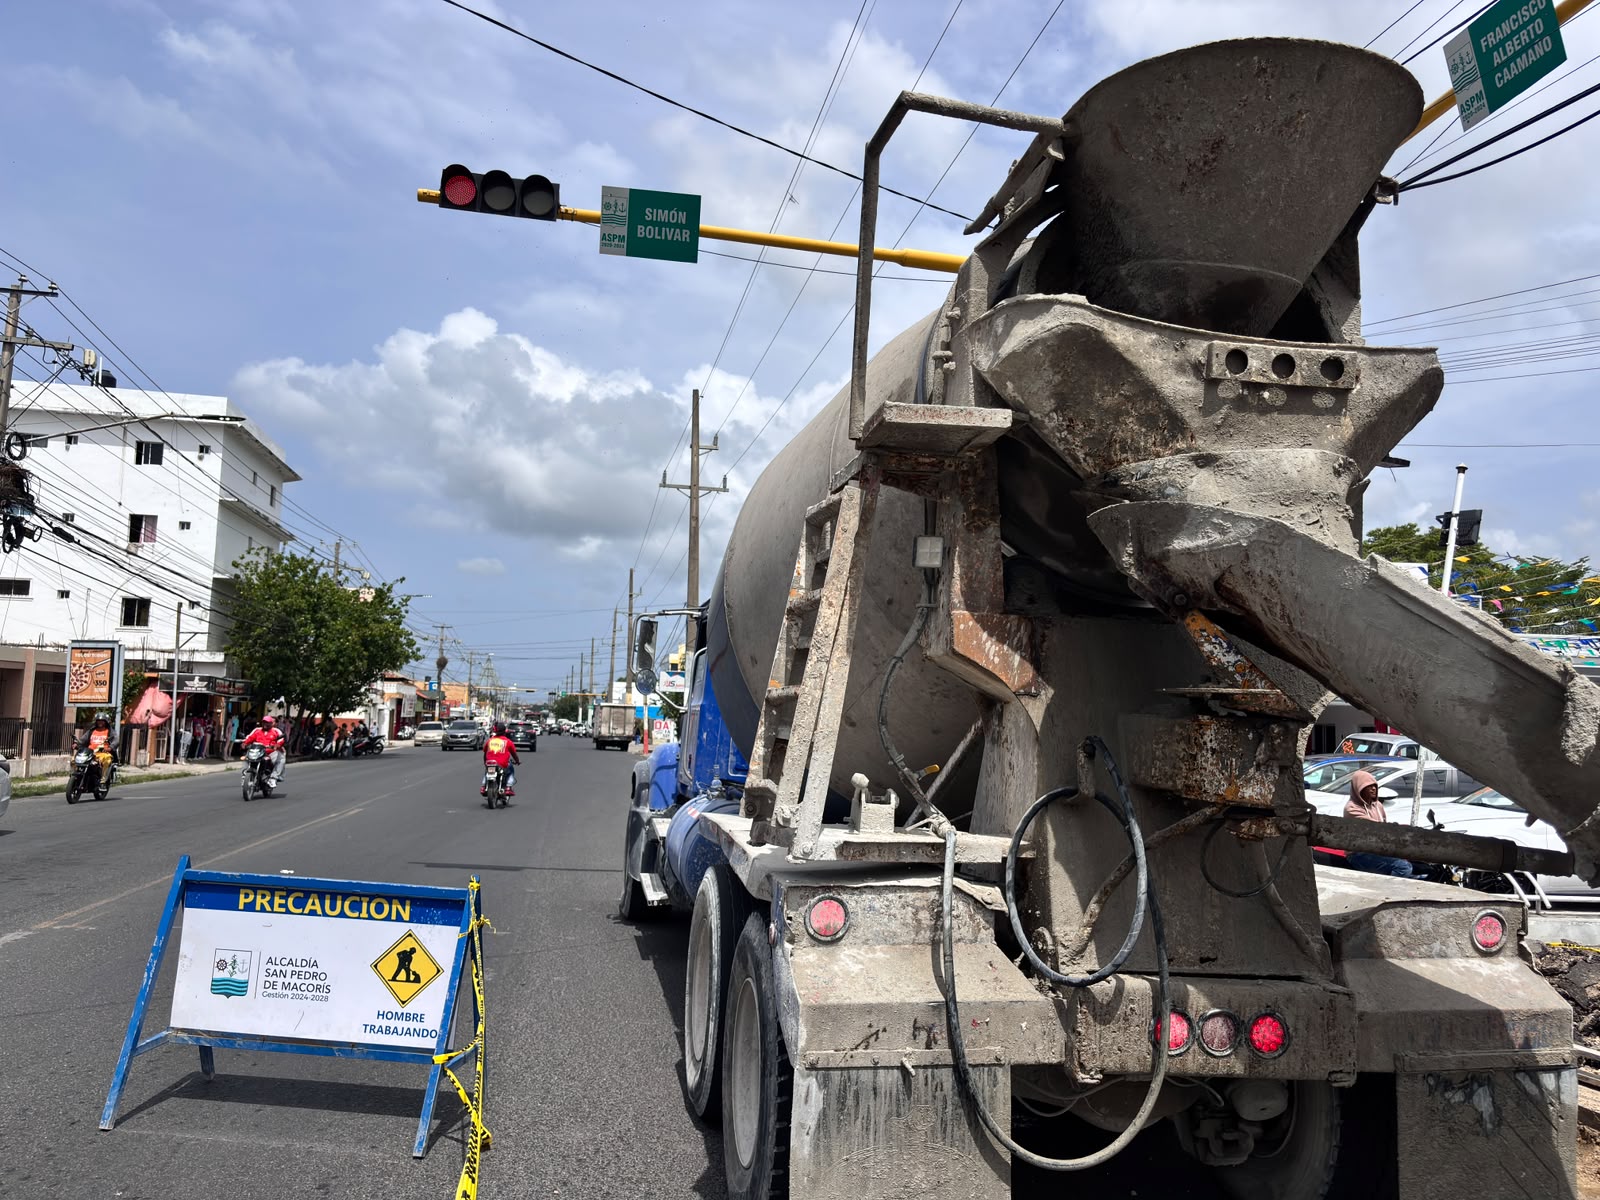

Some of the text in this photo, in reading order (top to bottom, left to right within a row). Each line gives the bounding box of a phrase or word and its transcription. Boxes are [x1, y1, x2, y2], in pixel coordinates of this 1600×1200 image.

[1480, 0, 1546, 53] FRANCISCO
[1492, 18, 1544, 67] ALBERTO
[1460, 89, 1484, 115] ASPM
[645, 207, 687, 224] SIMÓN
[601, 232, 626, 243] ASPM
[637, 225, 690, 242] BOLIVAR
[238, 888, 411, 921] PRECAUCION
[265, 956, 319, 969] ALCALDÍA
[264, 967, 328, 982] SAN PEDRO
[263, 979, 332, 995] DE MACORÍS
[261, 990, 329, 1003] Gestión 2024-2028
[376, 1010, 426, 1023] HOMBRE
[362, 1023, 438, 1039] TRABAJANDO
